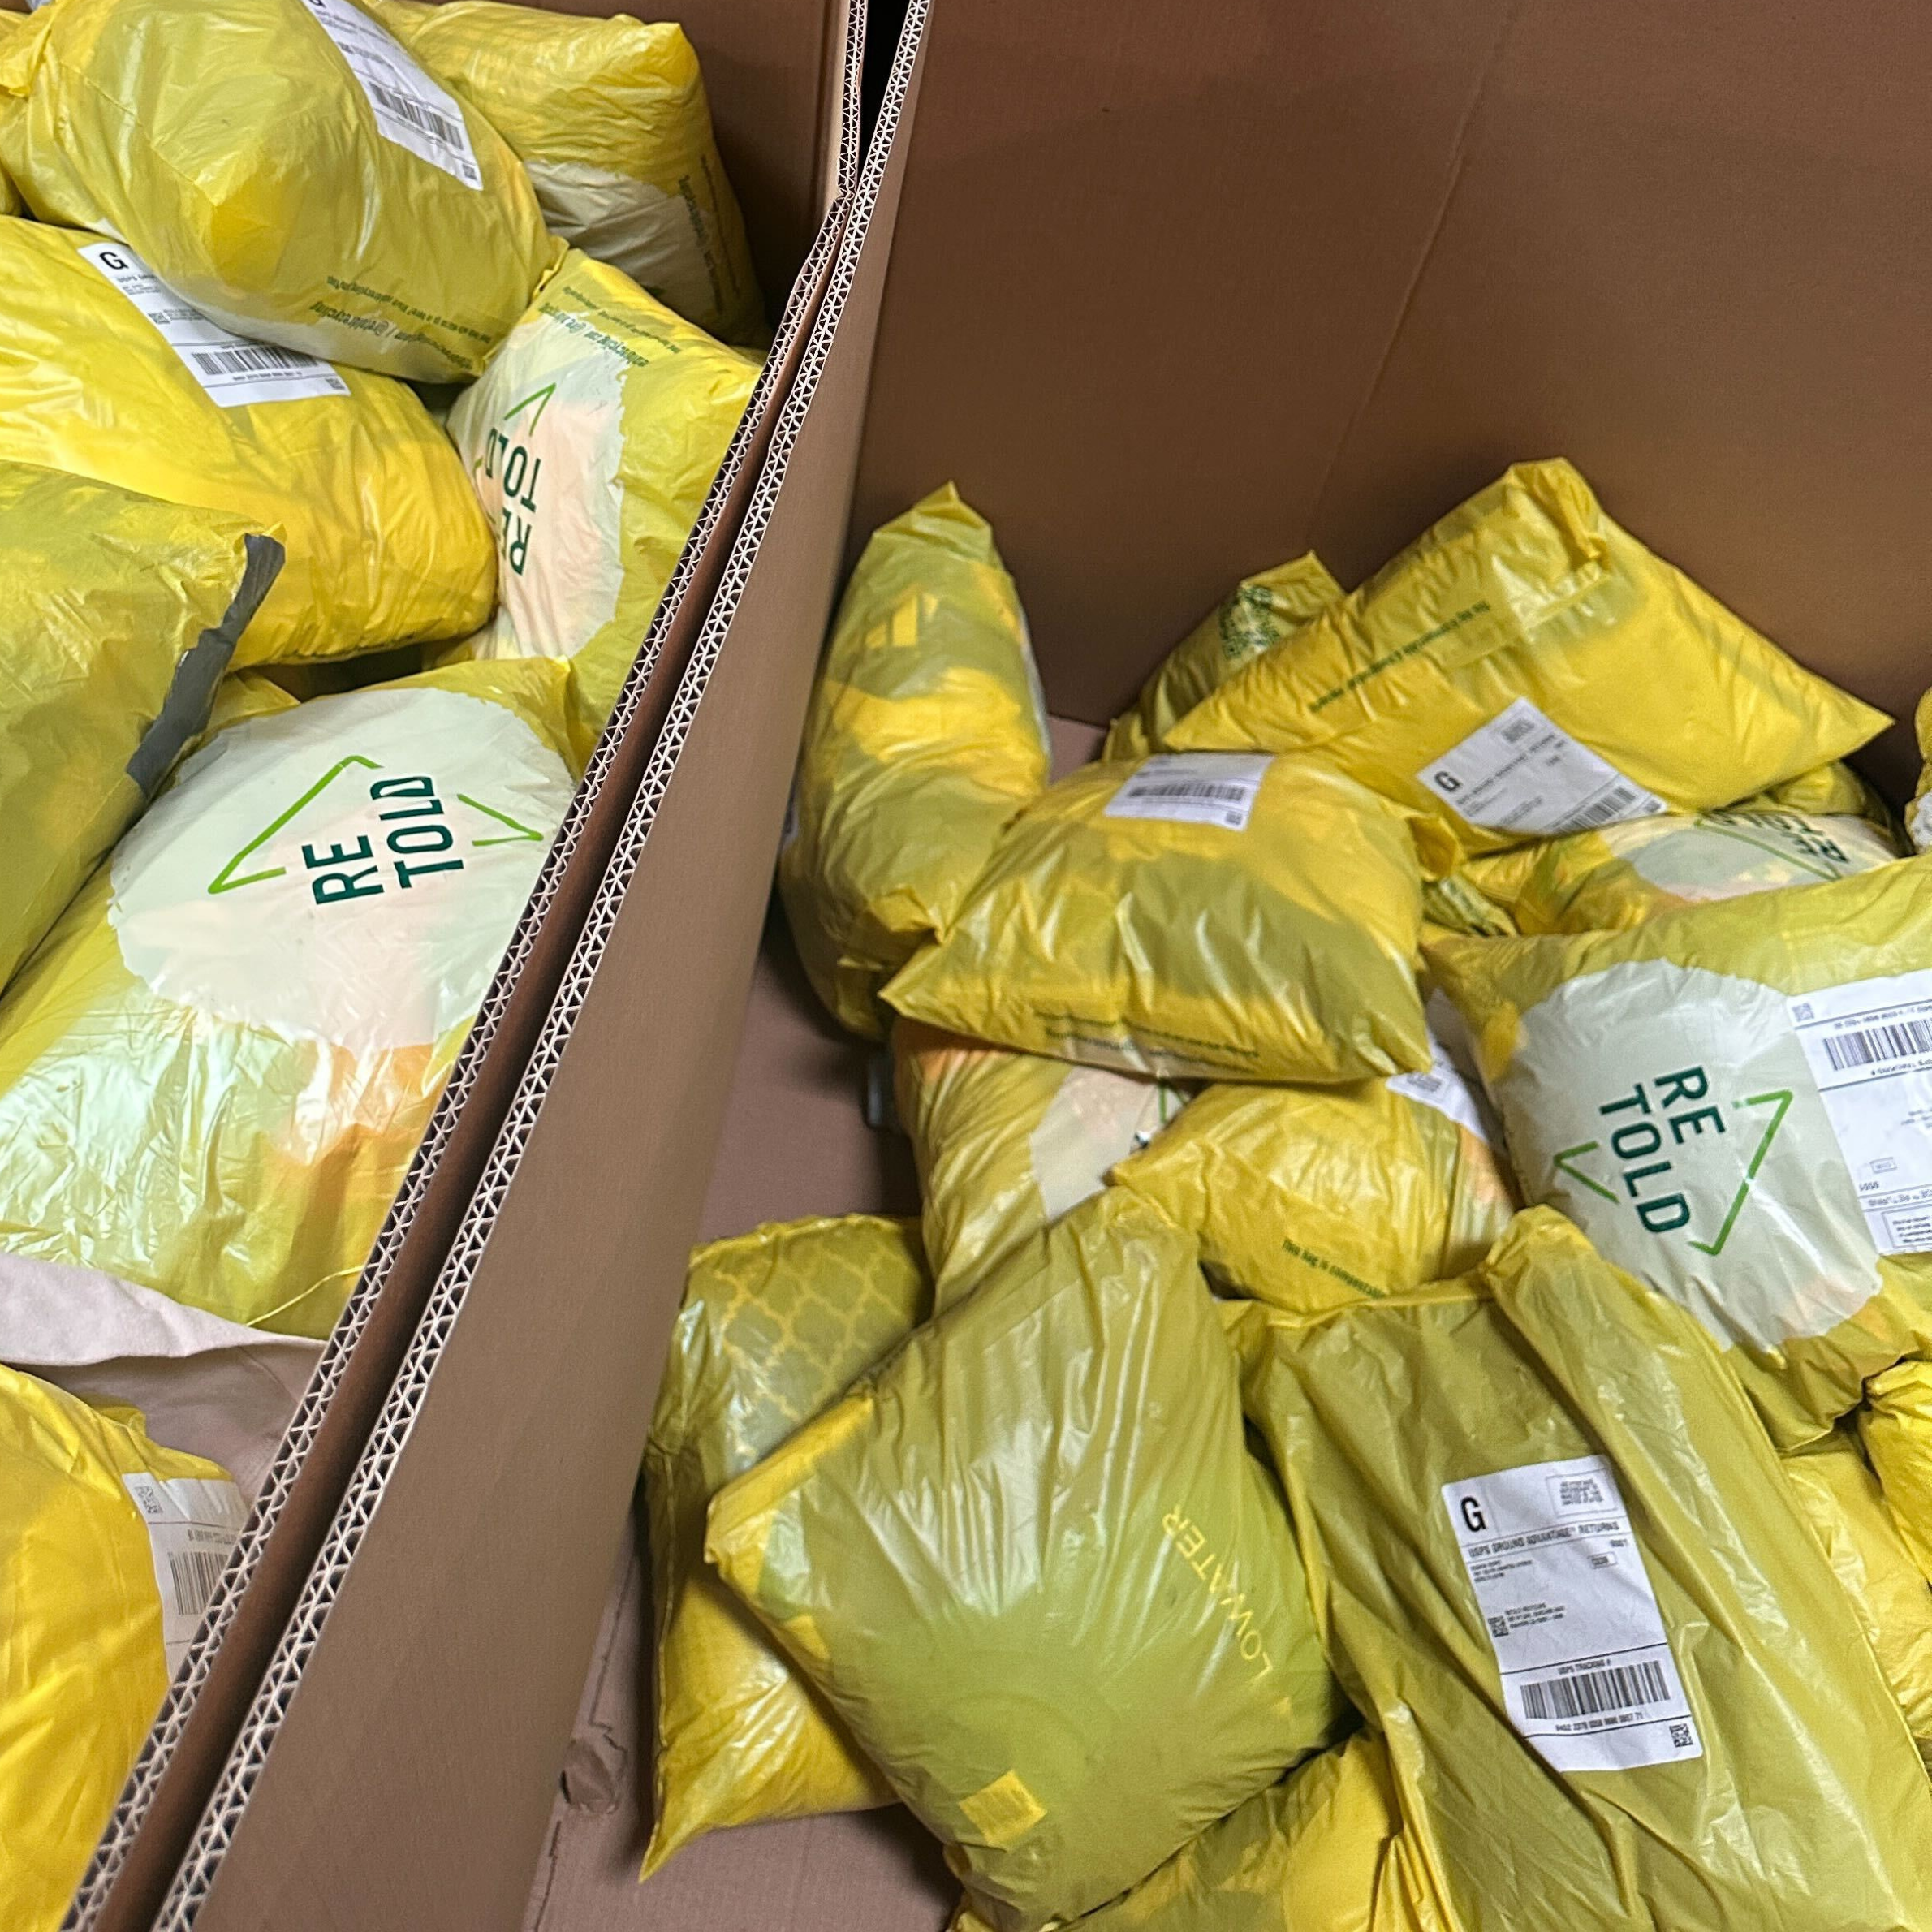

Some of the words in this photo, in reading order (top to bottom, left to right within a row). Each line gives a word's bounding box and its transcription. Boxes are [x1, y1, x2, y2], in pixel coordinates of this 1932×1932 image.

[99, 252, 129, 270] G
[1434, 770, 1463, 792] G
[369, 775, 464, 889] TOLD
[301, 834, 385, 905] RE
[1654, 1066, 1727, 1145] RE
[1599, 1083, 1691, 1233] TOLD
[1460, 1496, 1486, 1533] G
[1491, 1537, 1525, 1553] GROUND
[1162, 1503, 1274, 1685] LOWATER
